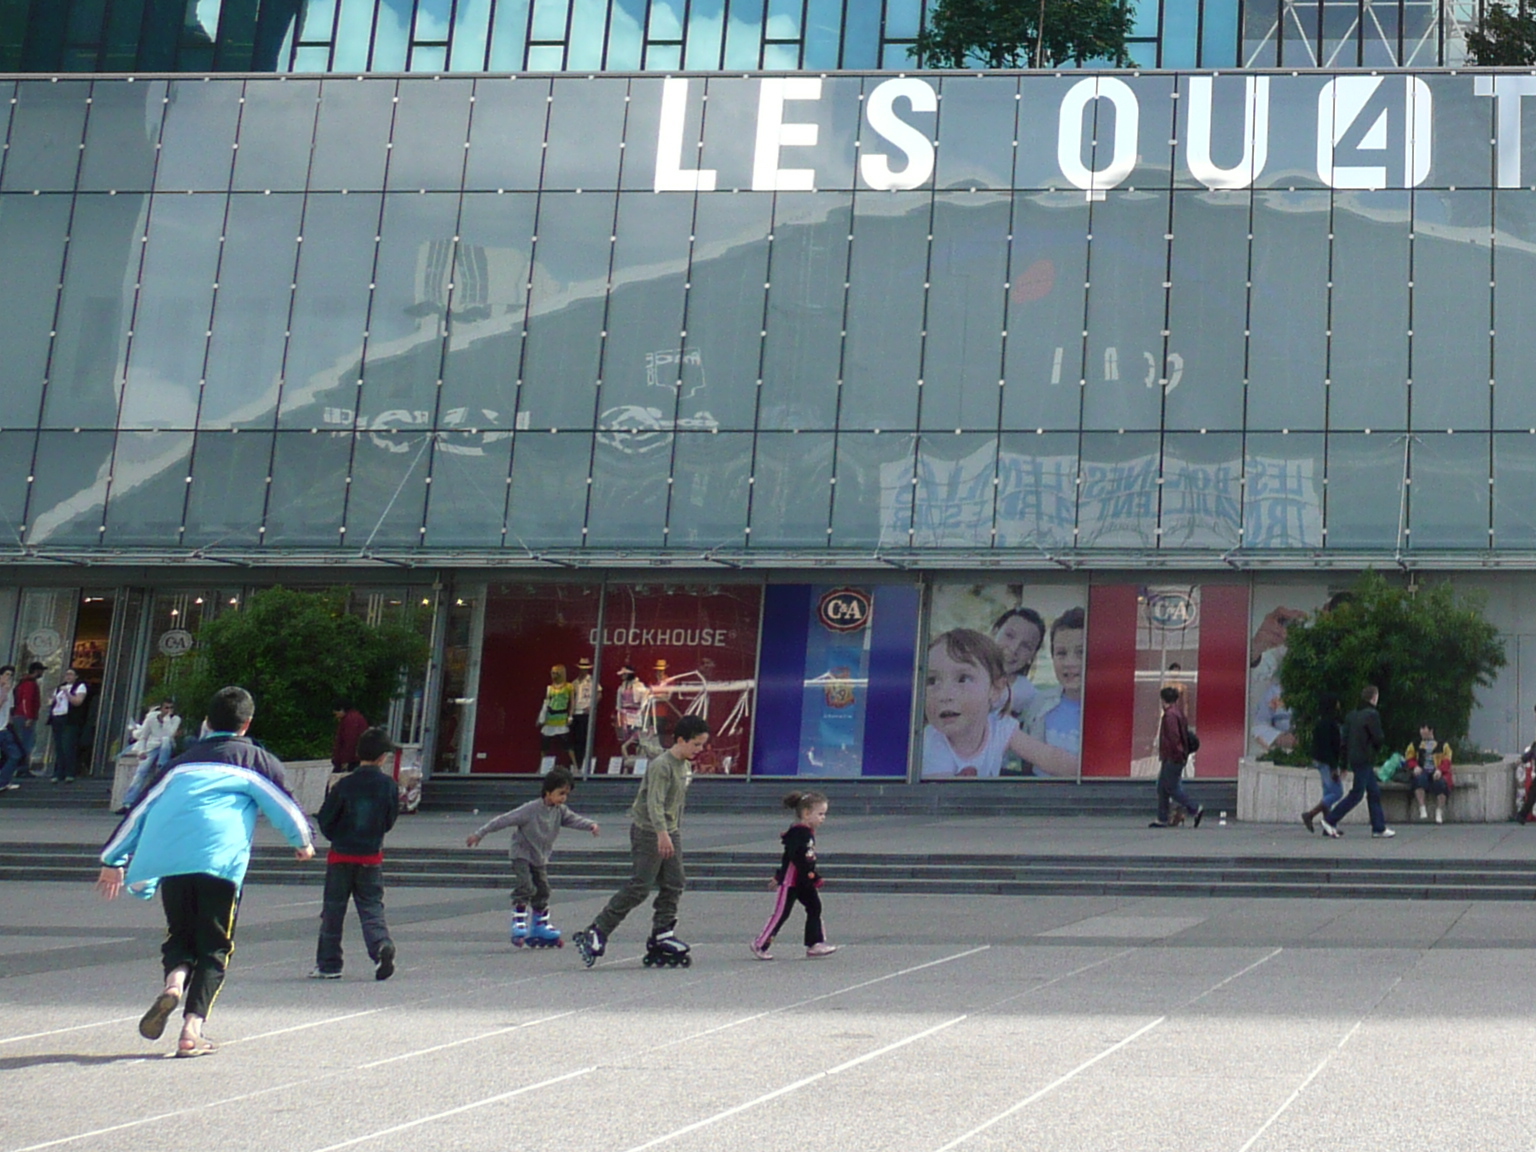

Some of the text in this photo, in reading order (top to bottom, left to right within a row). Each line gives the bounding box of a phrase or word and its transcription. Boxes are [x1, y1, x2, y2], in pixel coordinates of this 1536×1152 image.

[654, 75, 938, 192] LES
[827, 598, 863, 620] C&A
[1154, 599, 1189, 621] C&A
[588, 627, 728, 647] CLOCKHOUSE
